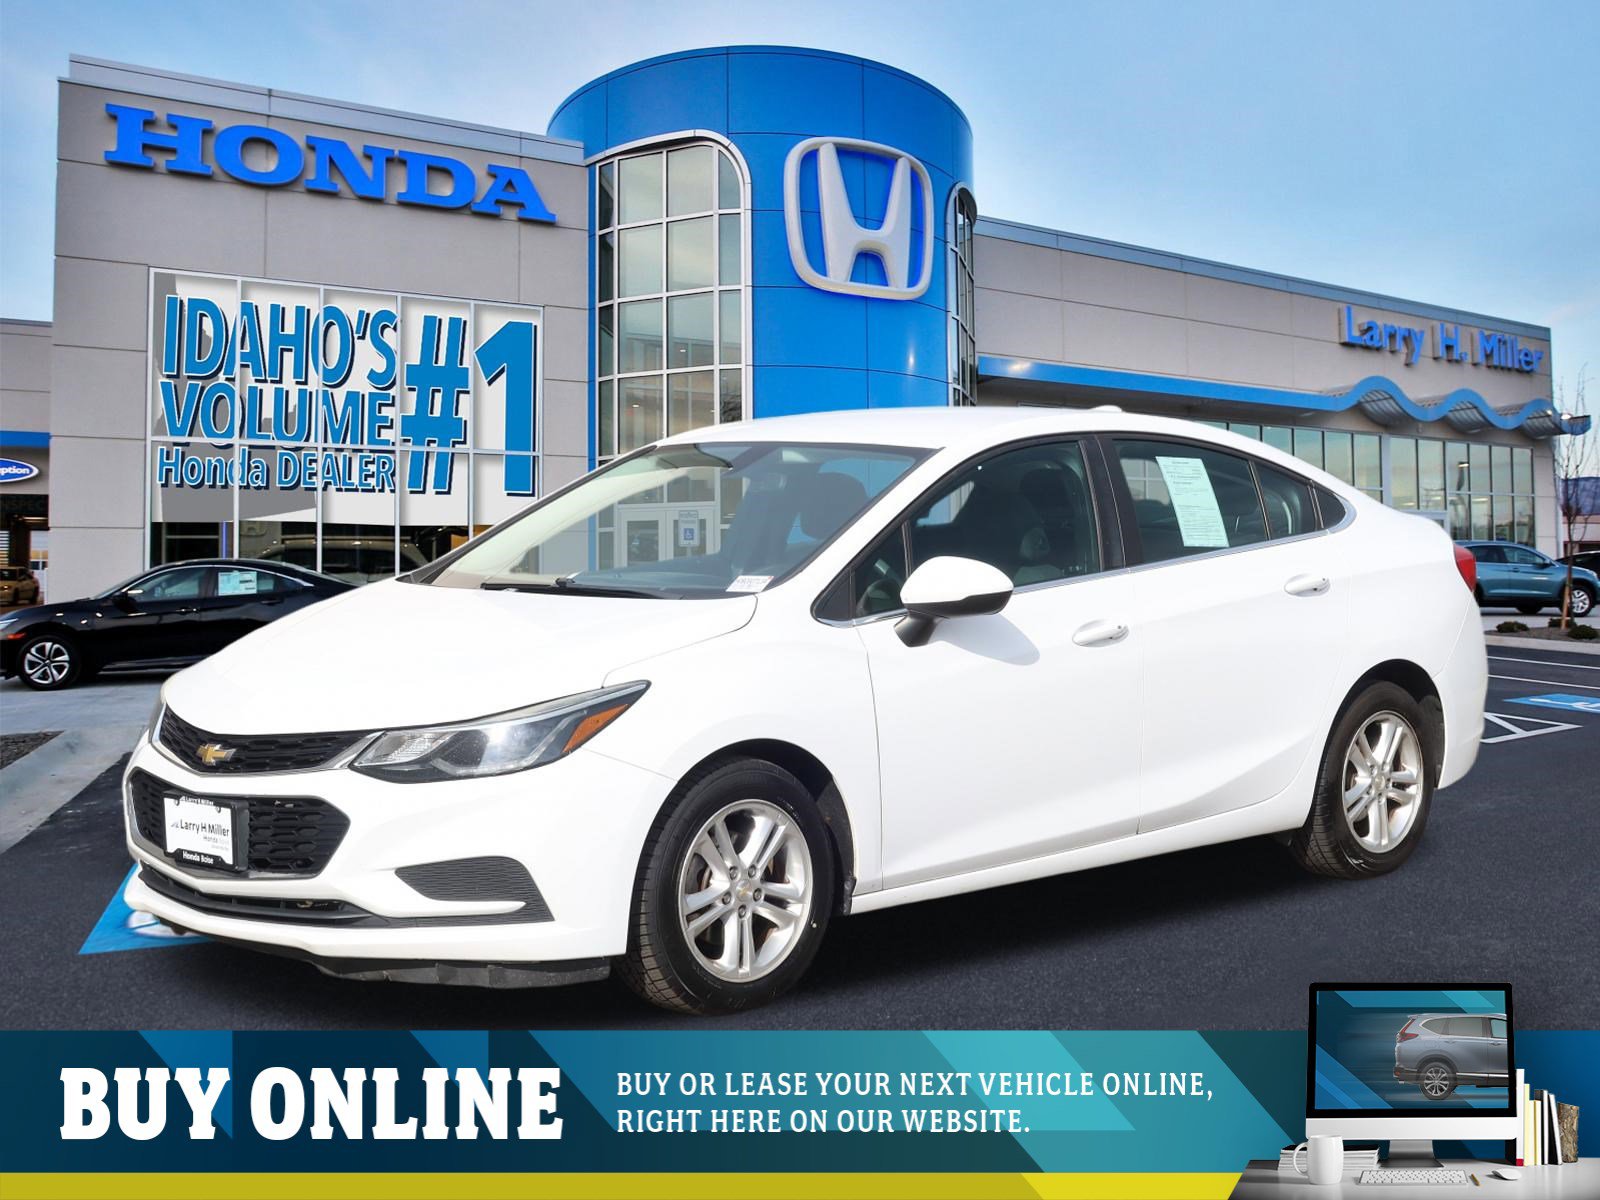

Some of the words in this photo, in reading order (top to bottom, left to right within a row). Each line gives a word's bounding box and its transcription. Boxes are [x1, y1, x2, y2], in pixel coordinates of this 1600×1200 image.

[104, 103, 557, 223] HONDA
[161, 295, 398, 390] IDAHO'S
[1342, 305, 1425, 366] Larry
[1436, 321, 1468, 362] H.
[1477, 329, 1545, 373] Miller
[159, 380, 396, 449] VOLUME
[156, 447, 267, 489] Honda
[276, 450, 396, 492] DEALER
[180, 818, 200, 835] Larry
[200, 821, 207, 832] H
[208, 823, 230, 837] Miller
